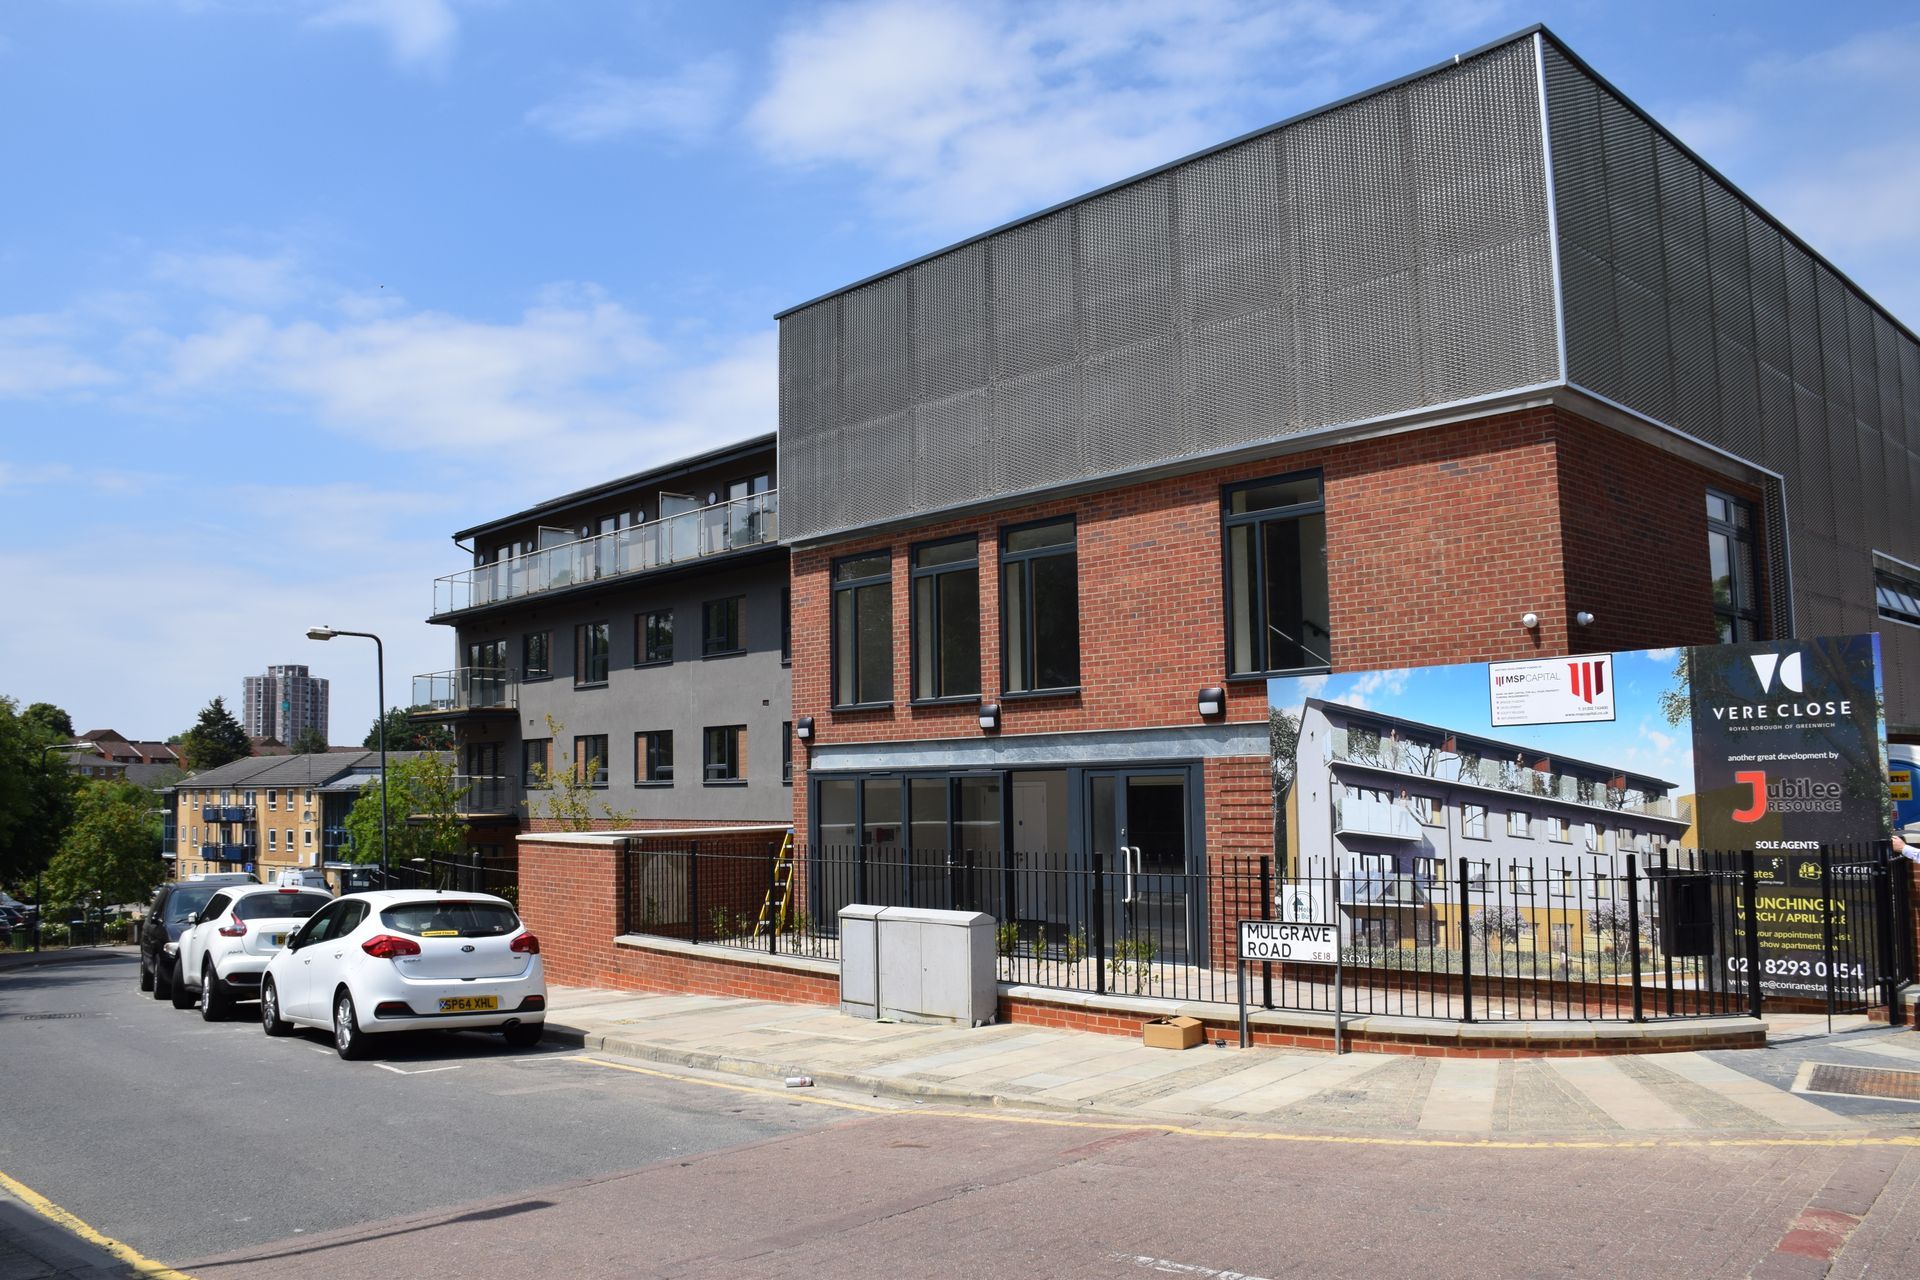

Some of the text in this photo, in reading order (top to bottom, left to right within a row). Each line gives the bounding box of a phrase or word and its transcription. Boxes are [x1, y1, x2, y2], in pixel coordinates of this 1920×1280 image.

[1713, 701, 1852, 720] VERE CLOSE
[1728, 751, 1839, 762] another great development by
[1731, 770, 1841, 823] Jubilee
[1768, 800, 1841, 812] RESOURCE
[1755, 841, 1819, 850] SOLE AGENTS
[1736, 896, 1846, 912] LUNCHING IN
[1738, 911, 1776, 922] MRCH
[1786, 913, 1818, 924] APRIL
[1247, 924, 1331, 943] MULGRAVE
[1774, 931, 1822, 941] appointment
[1247, 941, 1331, 961] ROAD SE18
[1760, 941, 1839, 952] show apartment nw
[1765, 959, 1811, 976] 8293
[445, 999, 494, 1010] SP64 XHL
